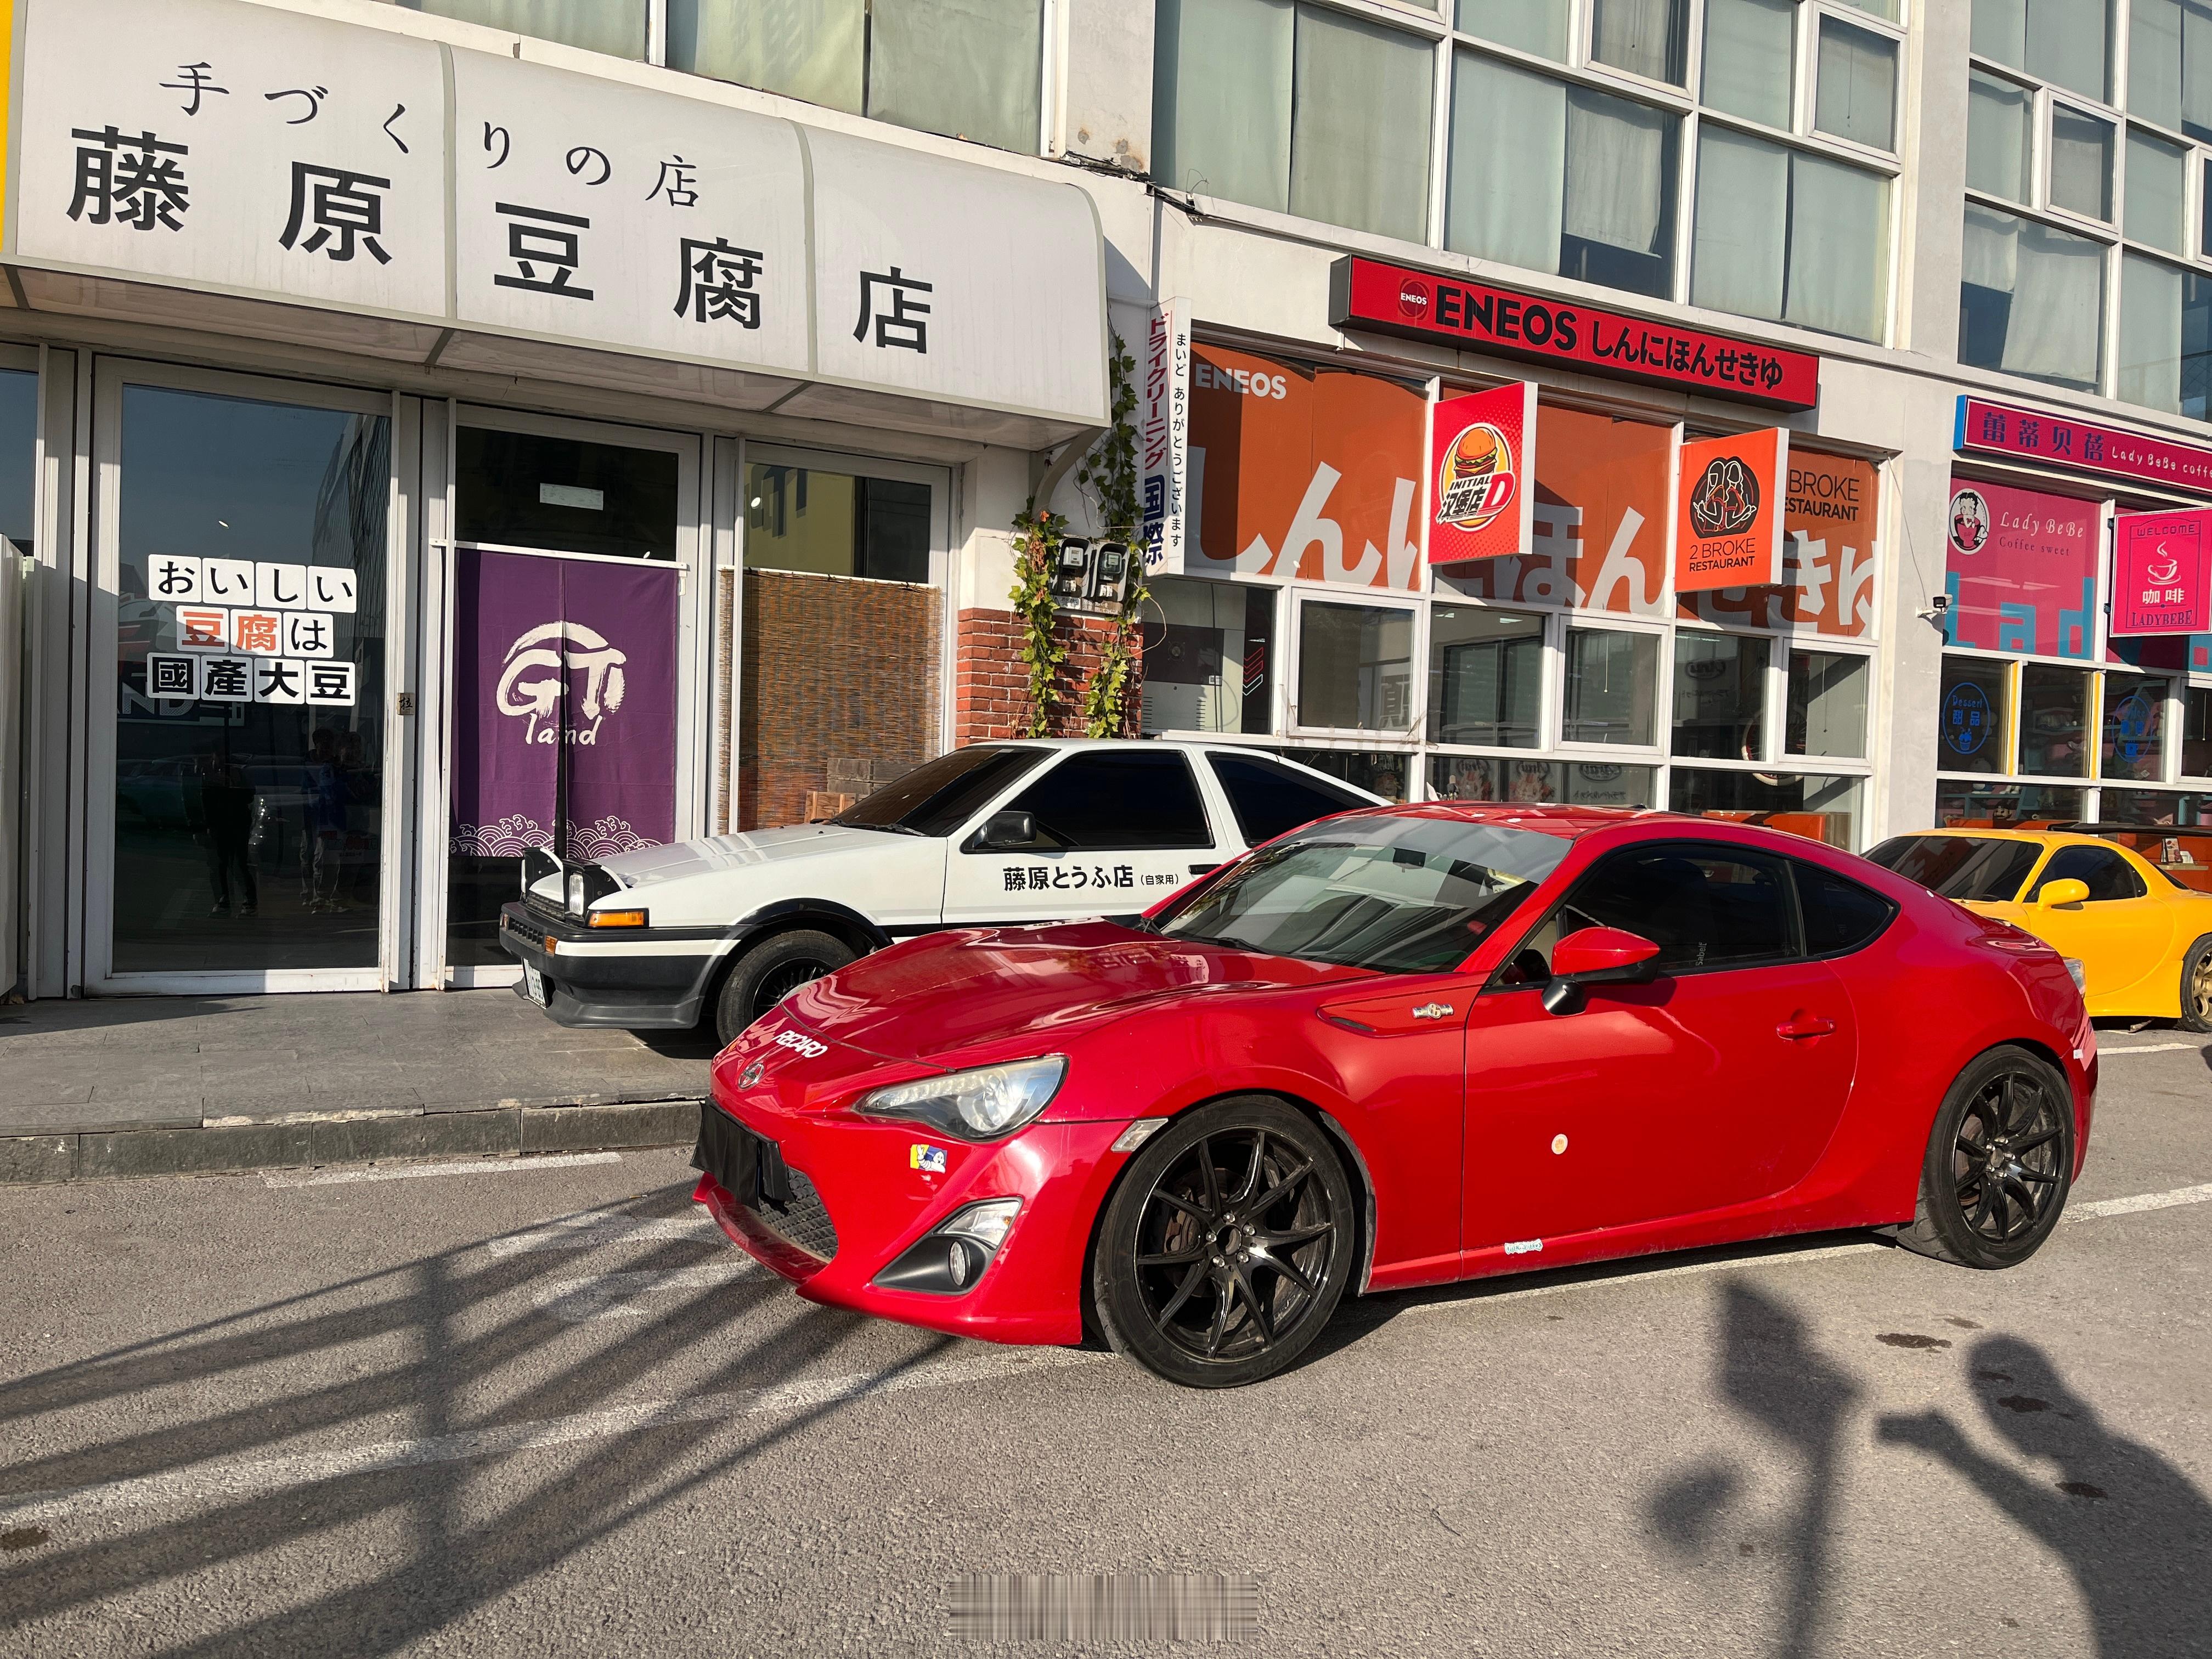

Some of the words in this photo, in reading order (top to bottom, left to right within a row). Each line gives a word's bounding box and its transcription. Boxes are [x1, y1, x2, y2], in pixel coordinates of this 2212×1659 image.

[159, 61, 698, 207] 手づくりの店
[66, 125, 933, 354] 藤原豆腐店
[1400, 292, 1427, 306] ENEOS
[1436, 285, 1577, 351] ENEOS
[1593, 320, 1782, 391] しんにほんせきゆ
[1144, 313, 1169, 470] ドライクリーニング
[1195, 363, 1286, 400] ENEOS
[2112, 446, 2143, 466] Lady
[2147, 453, 2176, 471] BeBe
[2182, 464, 2212, 478] coffe
[1449, 476, 1491, 490] INITIAL
[1789, 469, 1860, 502] BROKE
[1437, 486, 1487, 518] 汉堡店
[1785, 496, 1859, 521] ESTAURANT
[2000, 511, 2039, 537] Lady
[2045, 518, 2084, 538] BeBe
[2137, 524, 2195, 537] WELCOME
[1689, 544, 1698, 560] 2
[1702, 538, 1756, 558] BROKE
[1999, 537, 2035, 551] Coffee
[2041, 545, 2070, 556] sweet
[1689, 556, 1756, 572] RESTAURANT
[158, 561, 353, 603] おいしい
[2142, 588, 2185, 605] 咖啡
[181, 611, 328, 652] 豆腐は
[2132, 610, 2193, 627] LADYBEBE
[152, 657, 351, 700] 國產大豆
[525, 714, 602, 746] land
[1003, 865, 1134, 891] 藤原とうふ店
[1141, 873, 1180, 885] (自家用)
[772, 1030, 829, 1058] RECARO
